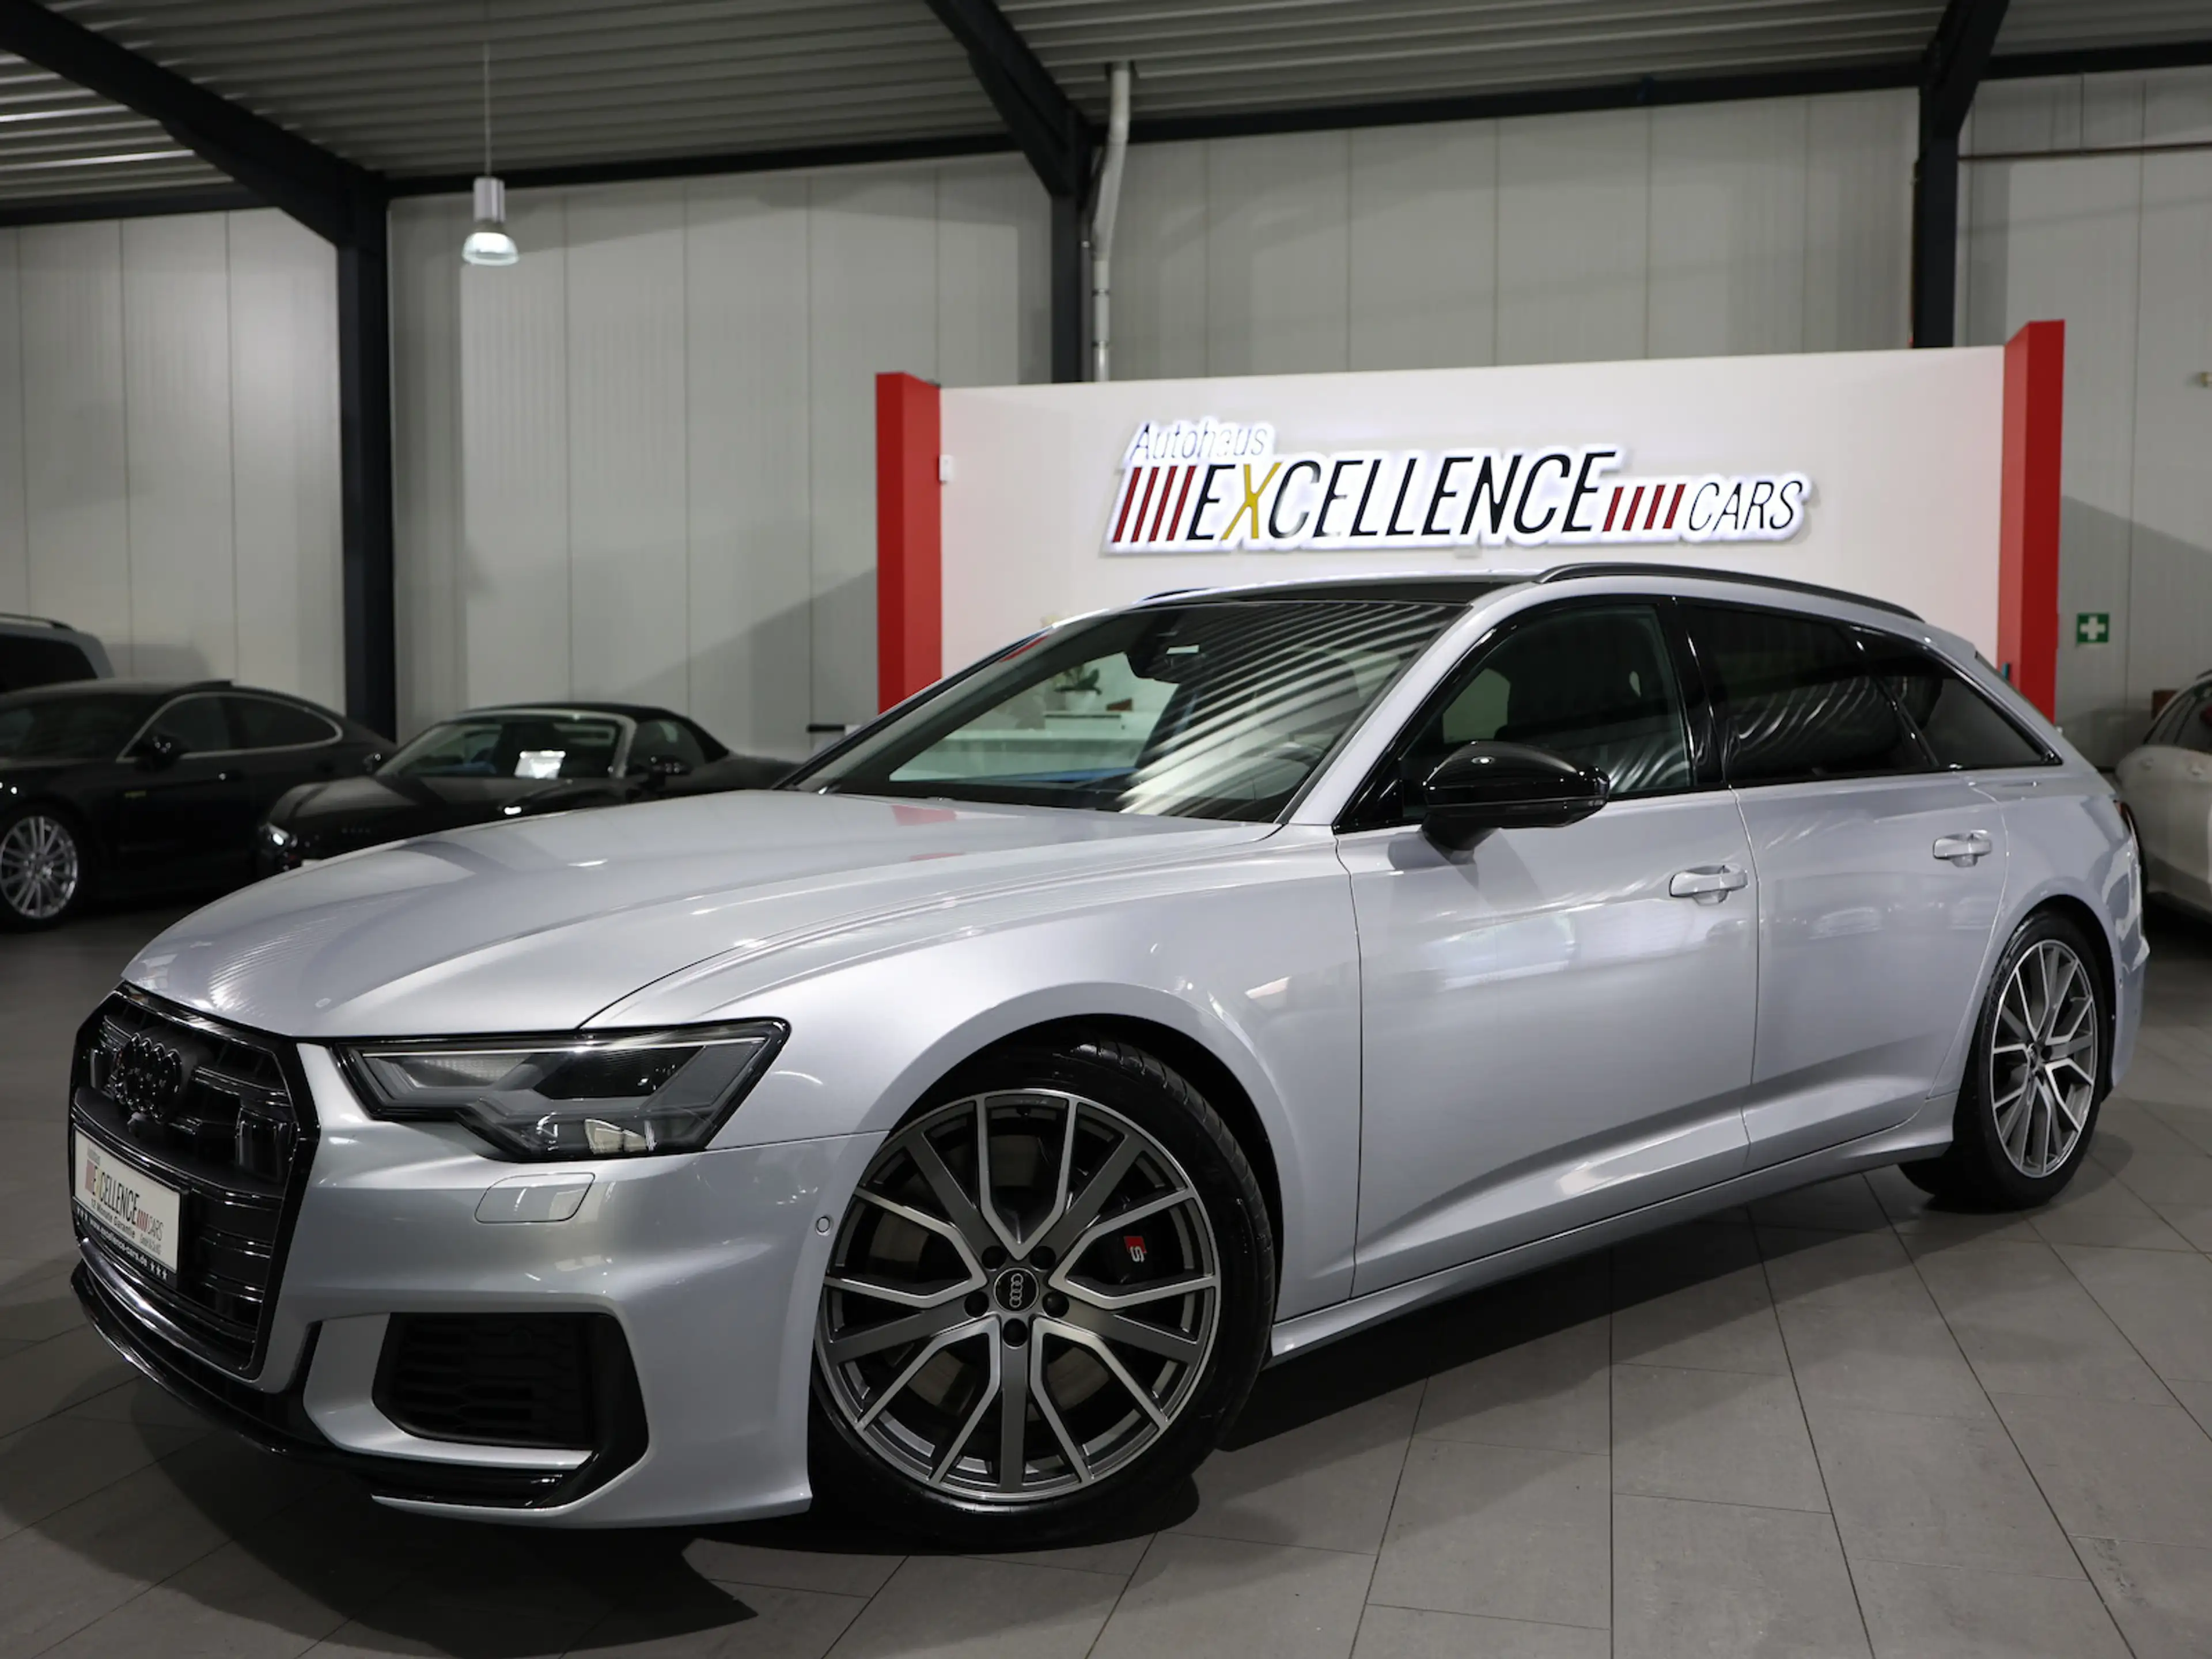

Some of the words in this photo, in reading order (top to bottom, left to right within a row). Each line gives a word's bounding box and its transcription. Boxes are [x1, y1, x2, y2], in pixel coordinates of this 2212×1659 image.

[1129, 422, 1268, 460] Autohaus
[1185, 451, 1616, 541] EXCELLENCE
[1688, 480, 1803, 532] CARS
